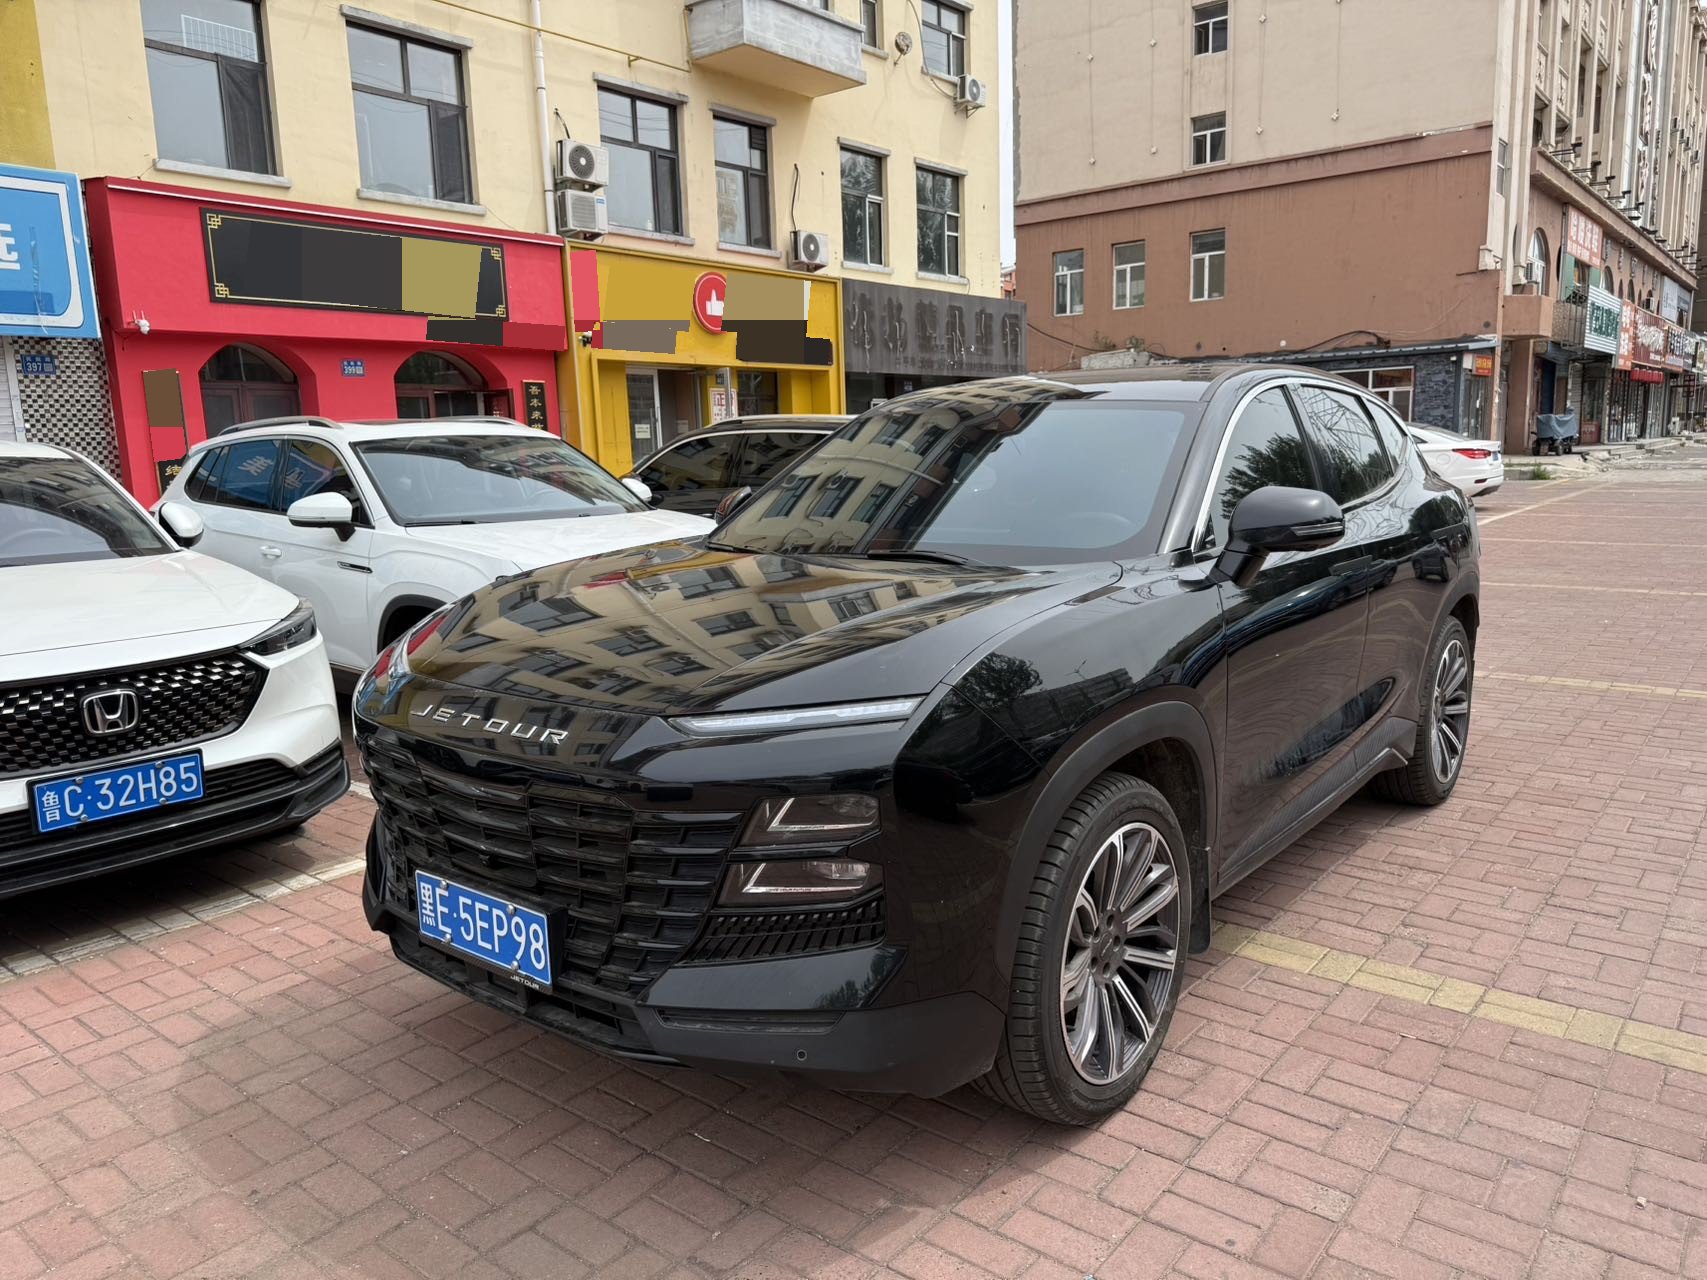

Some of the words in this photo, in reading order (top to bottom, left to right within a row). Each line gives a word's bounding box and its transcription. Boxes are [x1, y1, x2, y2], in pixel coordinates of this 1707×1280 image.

[26, 362, 42, 372] 397
[410, 705, 568, 744] JETOUR
[510, 974, 540, 990] JETOUR
